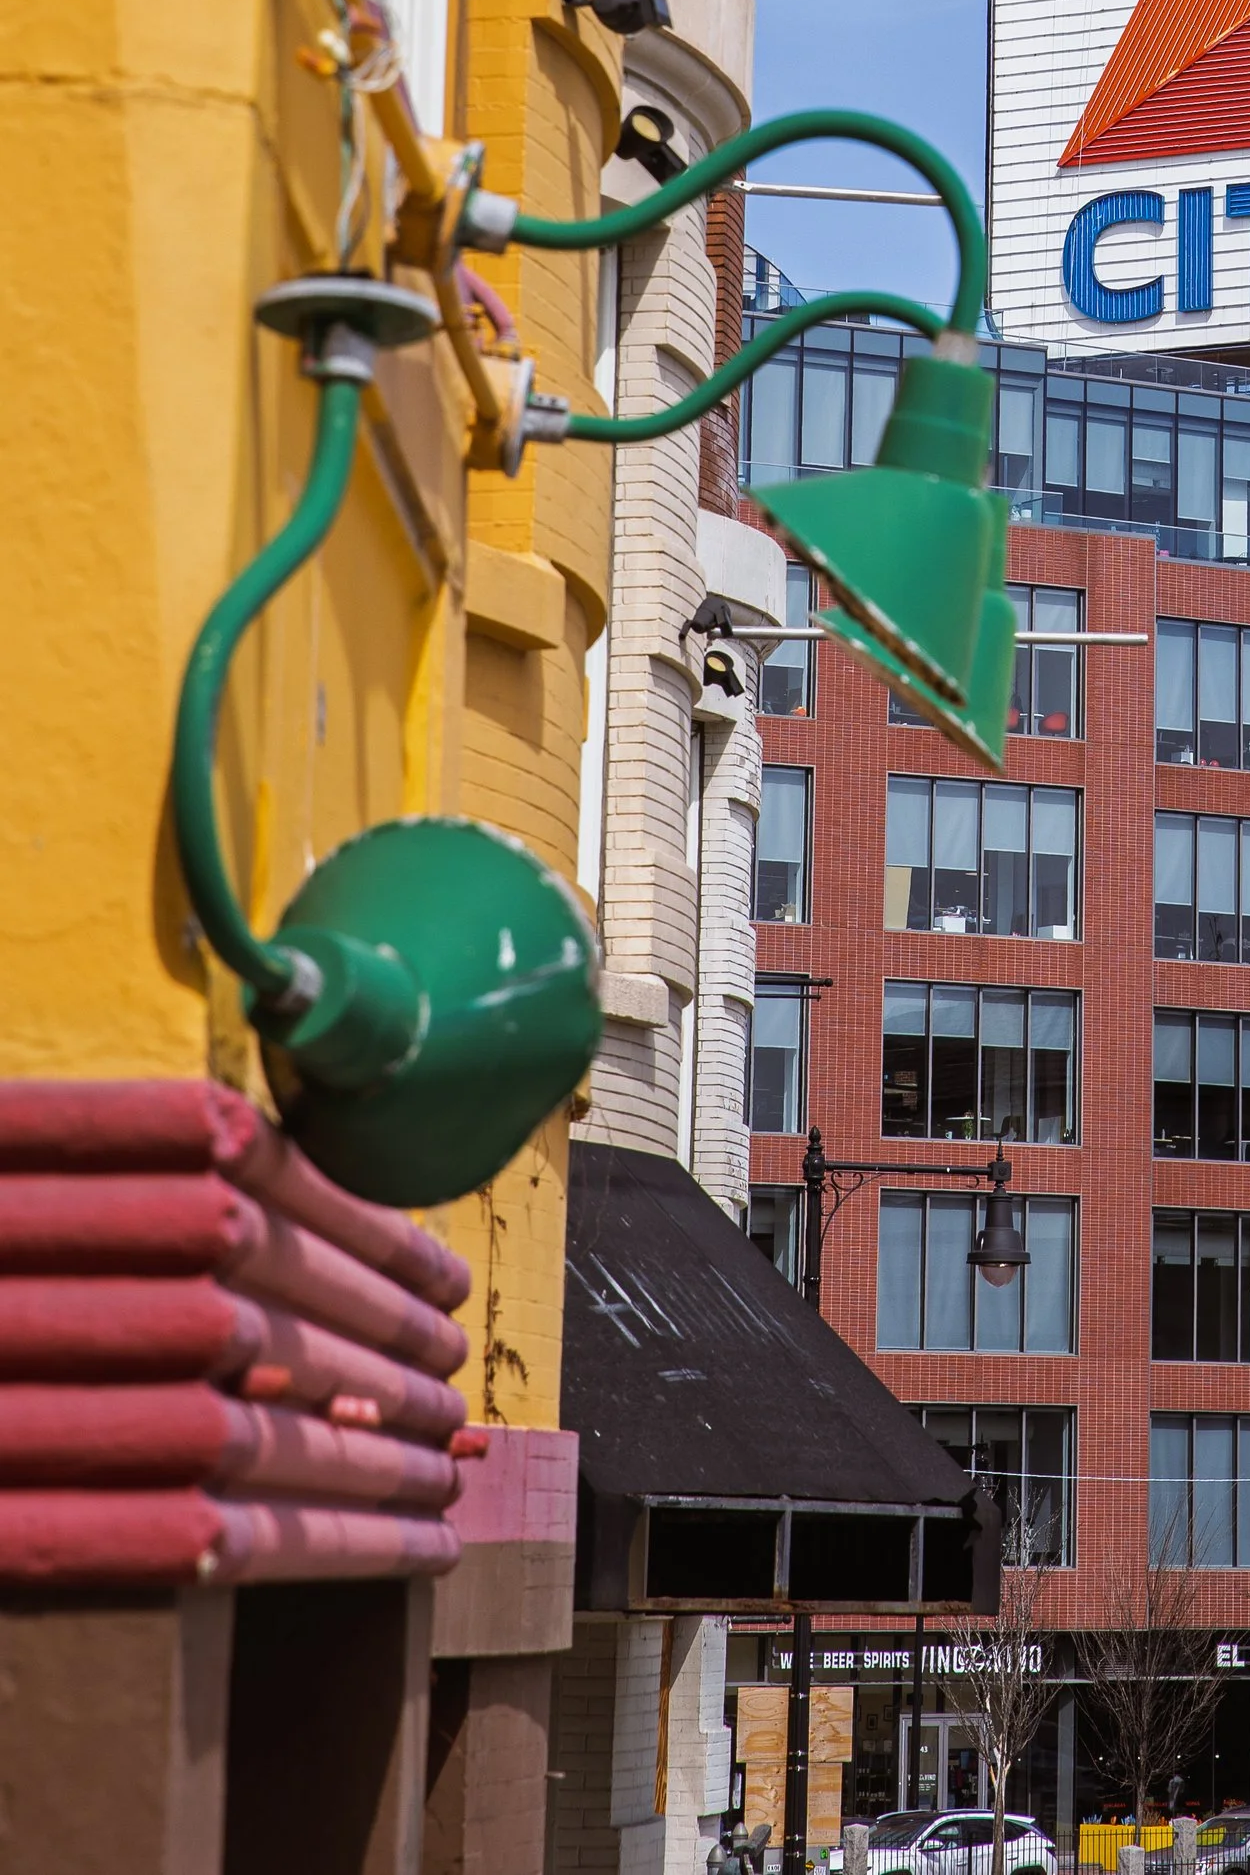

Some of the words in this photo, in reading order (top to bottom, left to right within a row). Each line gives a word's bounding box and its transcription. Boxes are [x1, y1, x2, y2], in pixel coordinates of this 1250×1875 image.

[823, 1651, 854, 1669] BEER
[863, 1651, 909, 1669] SPIRITS
[1216, 1644, 1245, 1667] EL
